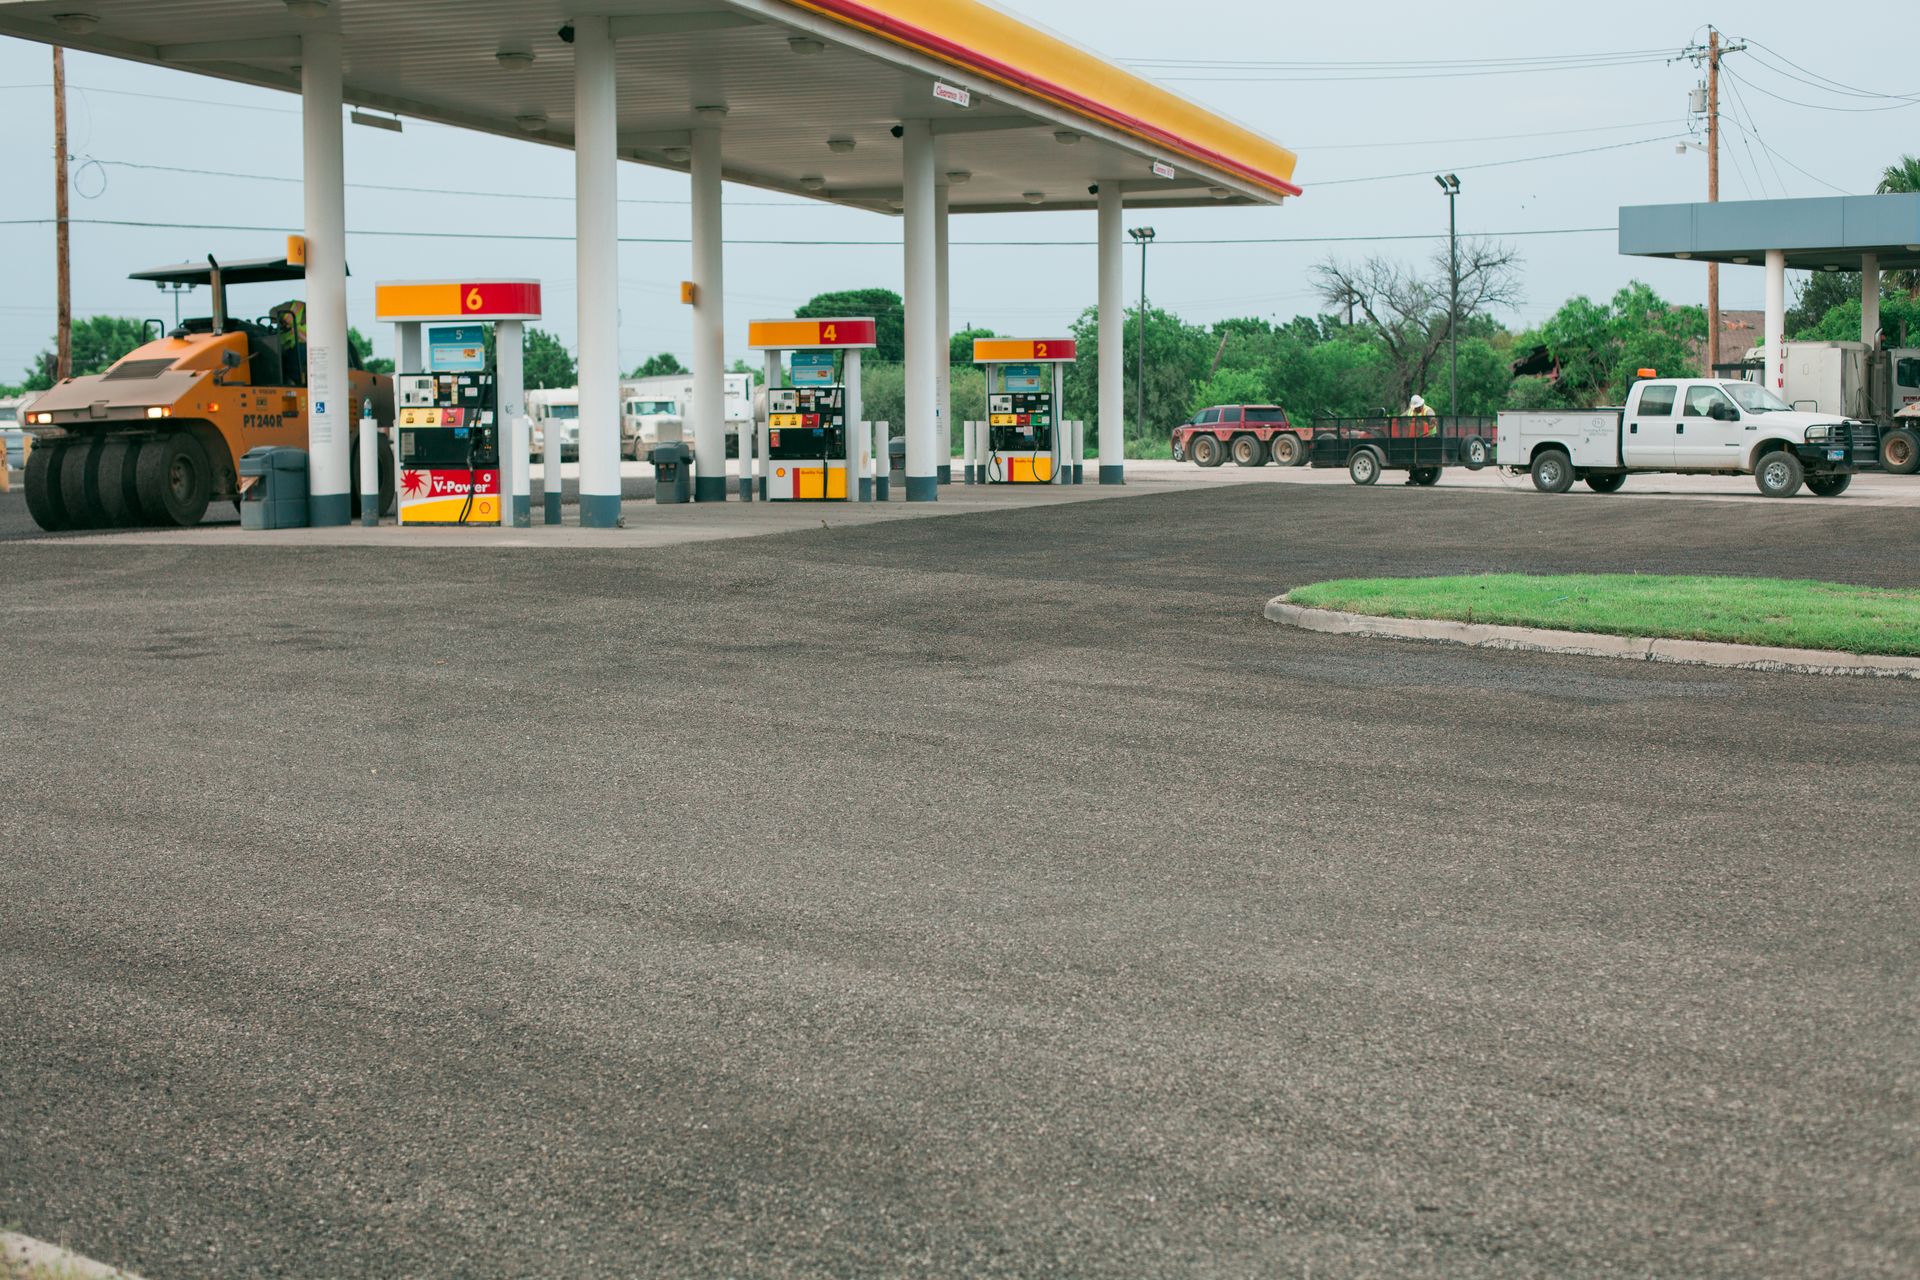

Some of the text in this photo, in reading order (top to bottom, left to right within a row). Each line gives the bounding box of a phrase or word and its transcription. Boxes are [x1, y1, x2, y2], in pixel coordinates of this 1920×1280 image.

[466, 288, 483, 311] 6
[823, 324, 837, 341] 4
[1036, 343, 1047, 357] 2
[433, 480, 488, 493] V-Power
